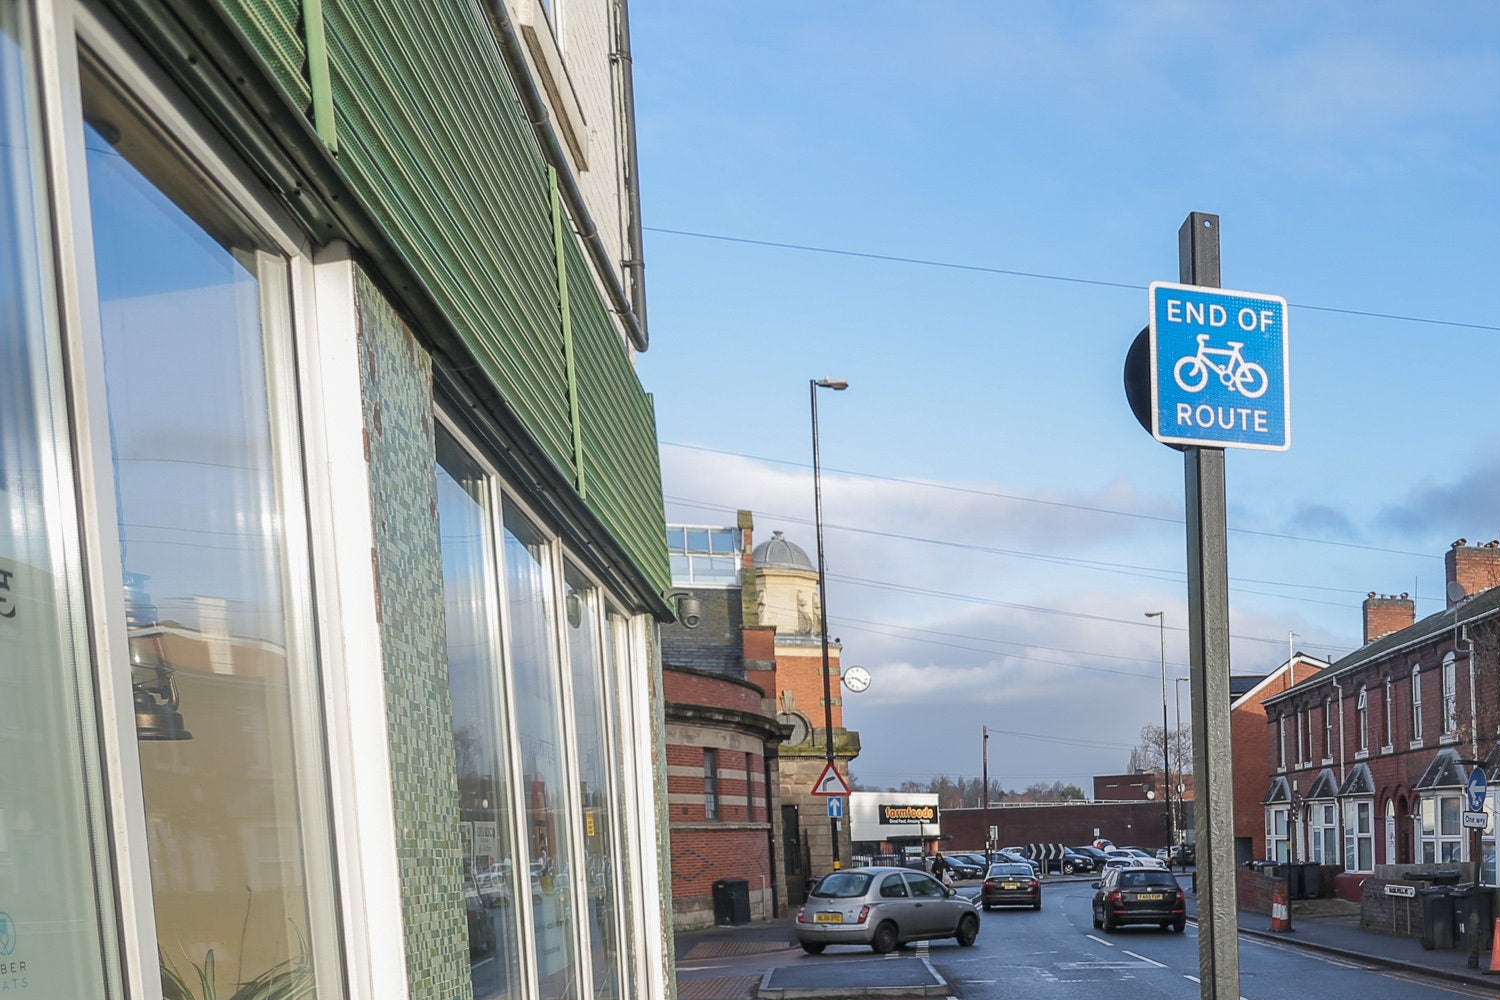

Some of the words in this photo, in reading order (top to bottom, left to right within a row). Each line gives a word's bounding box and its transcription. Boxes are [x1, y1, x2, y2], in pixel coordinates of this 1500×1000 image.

[1167, 299, 1227, 328] END
[1238, 308, 1273, 333] OF
[1177, 403, 1268, 433] ROUTE
[885, 806, 934, 819] farmfoods
[1465, 815, 1475, 824] One
[1476, 818, 1485, 826] way
